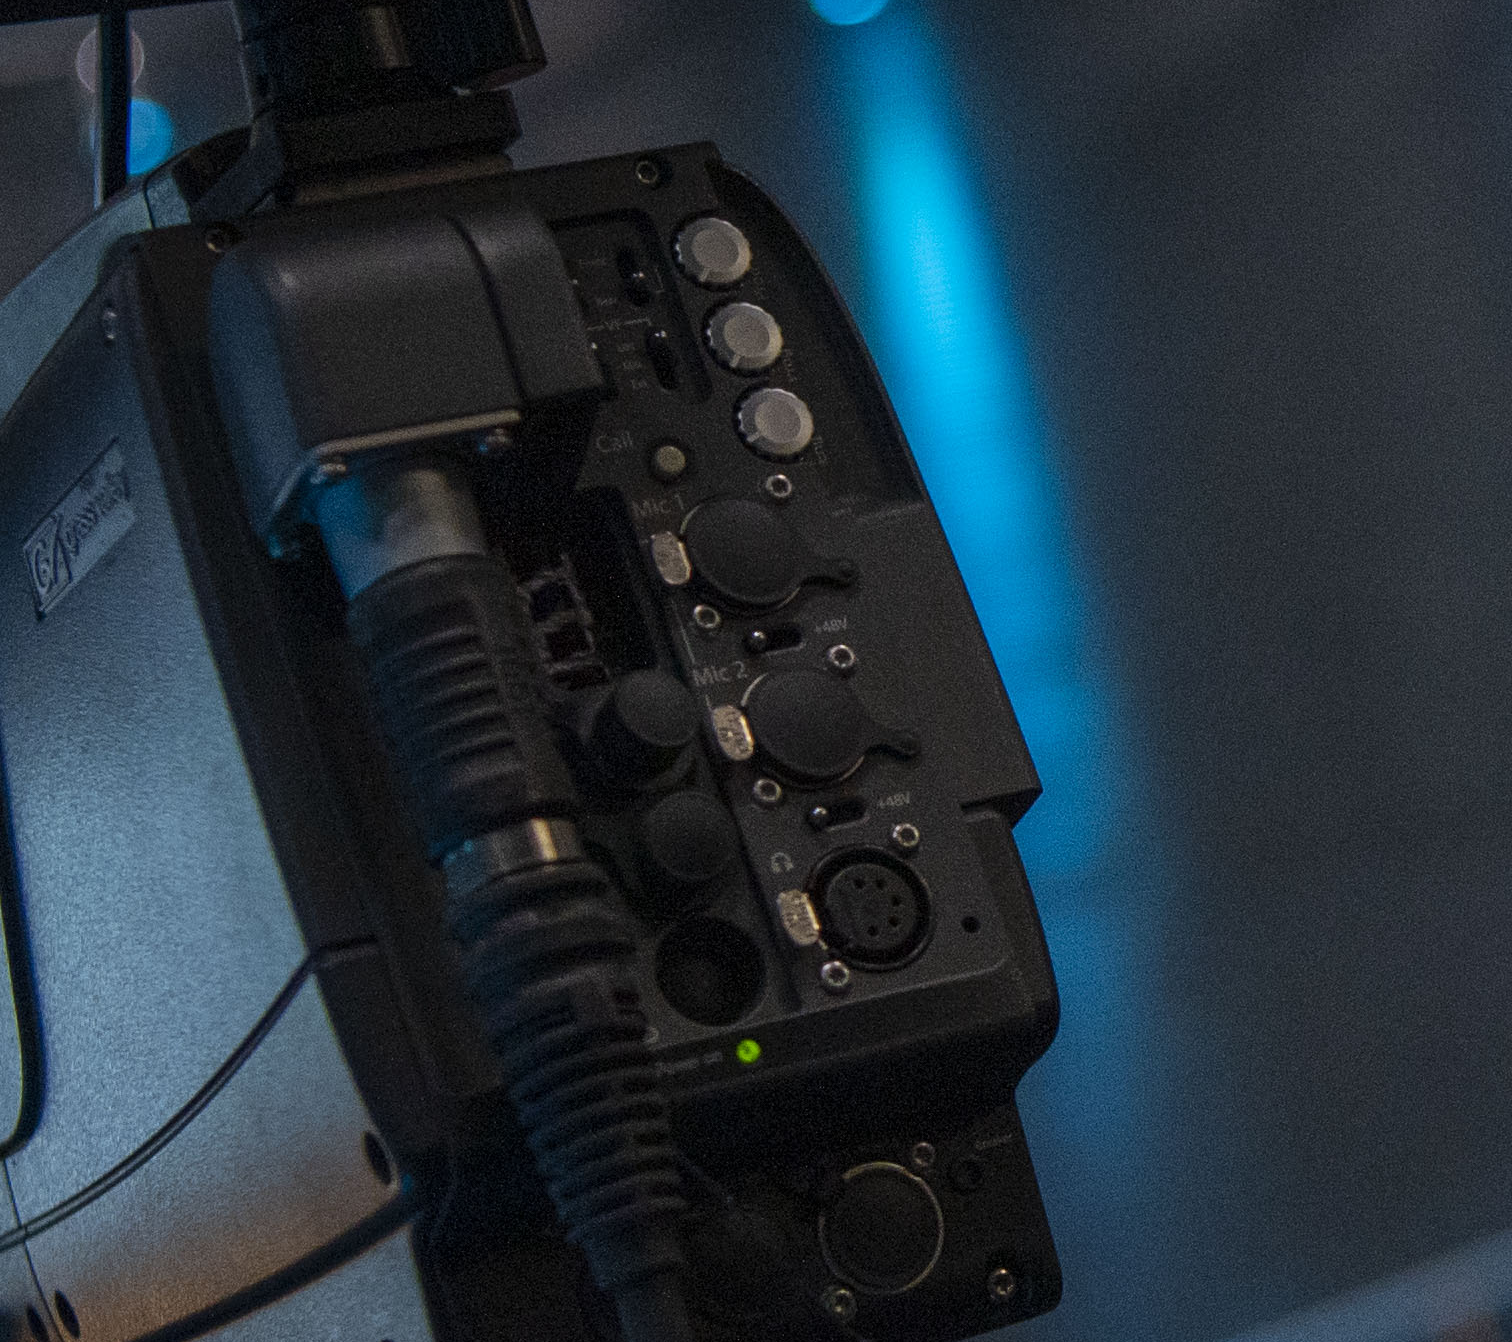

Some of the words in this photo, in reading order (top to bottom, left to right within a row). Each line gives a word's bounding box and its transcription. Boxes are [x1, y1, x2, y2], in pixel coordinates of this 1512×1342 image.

[631, 496, 668, 519] Mic
[692, 665, 729, 687] Mic
[734, 660, 749, 680] 2
